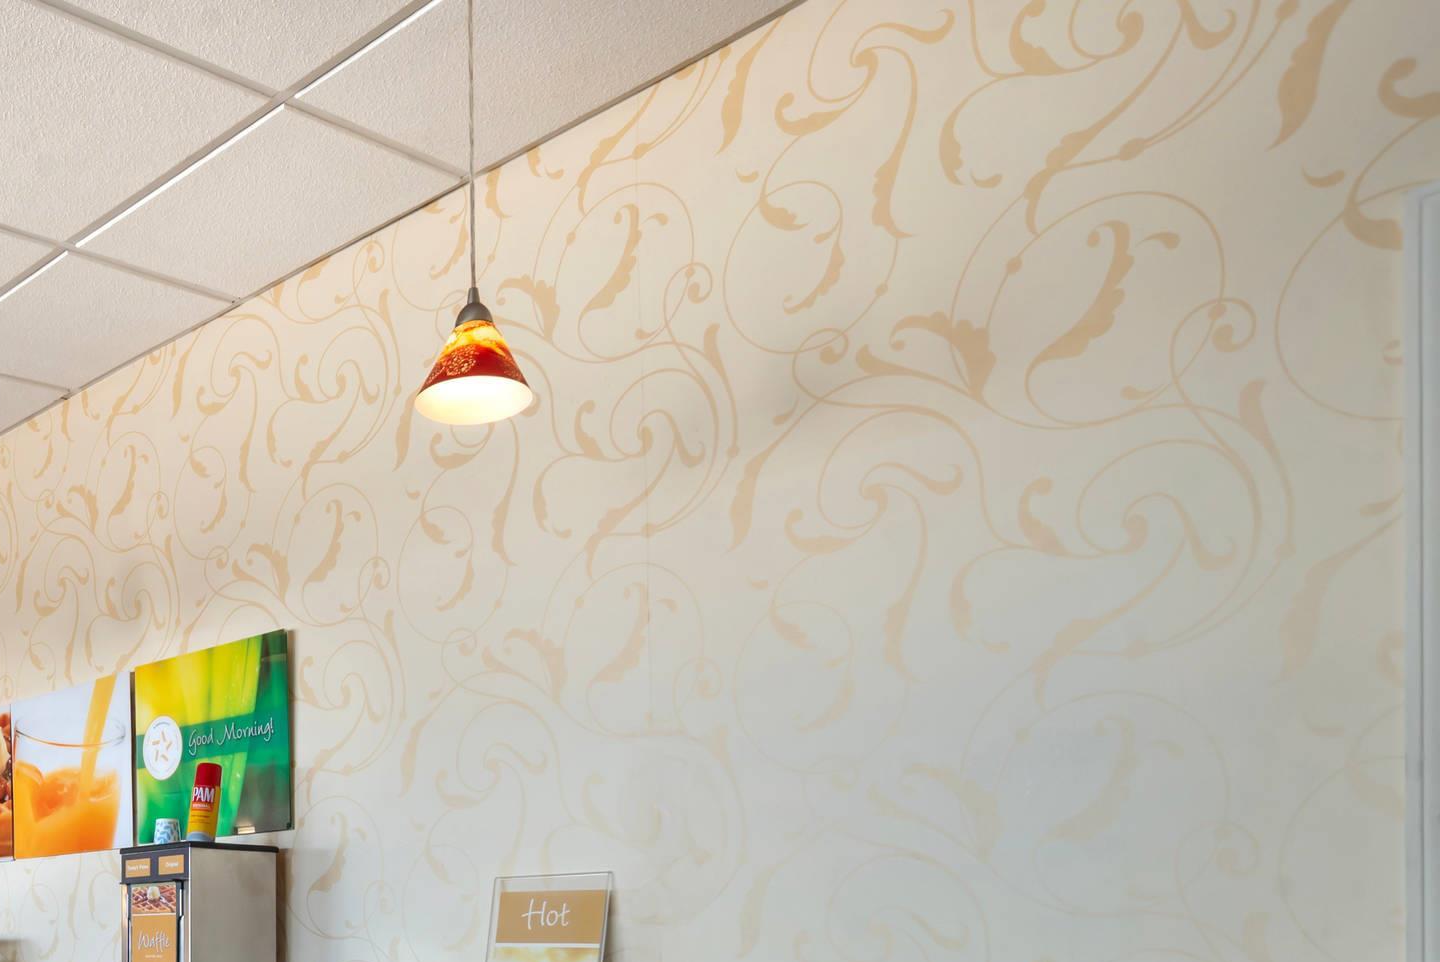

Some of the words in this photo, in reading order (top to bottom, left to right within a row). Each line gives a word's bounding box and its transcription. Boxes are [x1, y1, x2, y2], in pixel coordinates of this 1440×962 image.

[189, 728, 214, 756] Good
[216, 717, 274, 742] Morning!
[192, 786, 215, 803] PAM
[521, 898, 570, 930] Hot
[137, 930, 169, 952] Waffle
